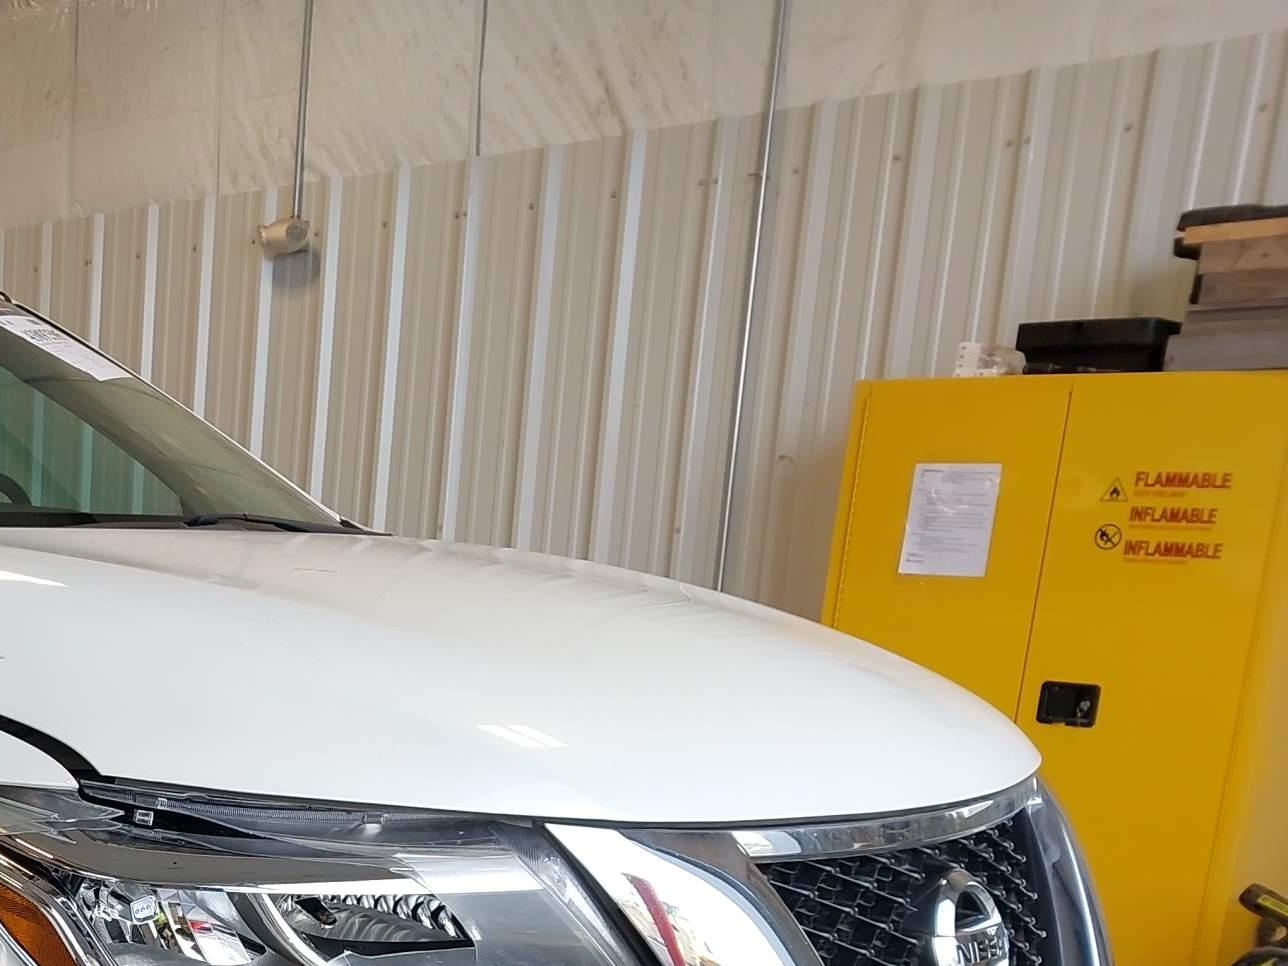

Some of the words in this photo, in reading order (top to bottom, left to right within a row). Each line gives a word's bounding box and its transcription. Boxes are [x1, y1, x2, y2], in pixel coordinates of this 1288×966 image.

[1135, 471, 1233, 489] FLAMMABLE
[1129, 506, 1219, 524] INFLAMABLE
[1123, 540, 1224, 559] INFLAMMABLE
[956, 936, 1009, 965] NISS
